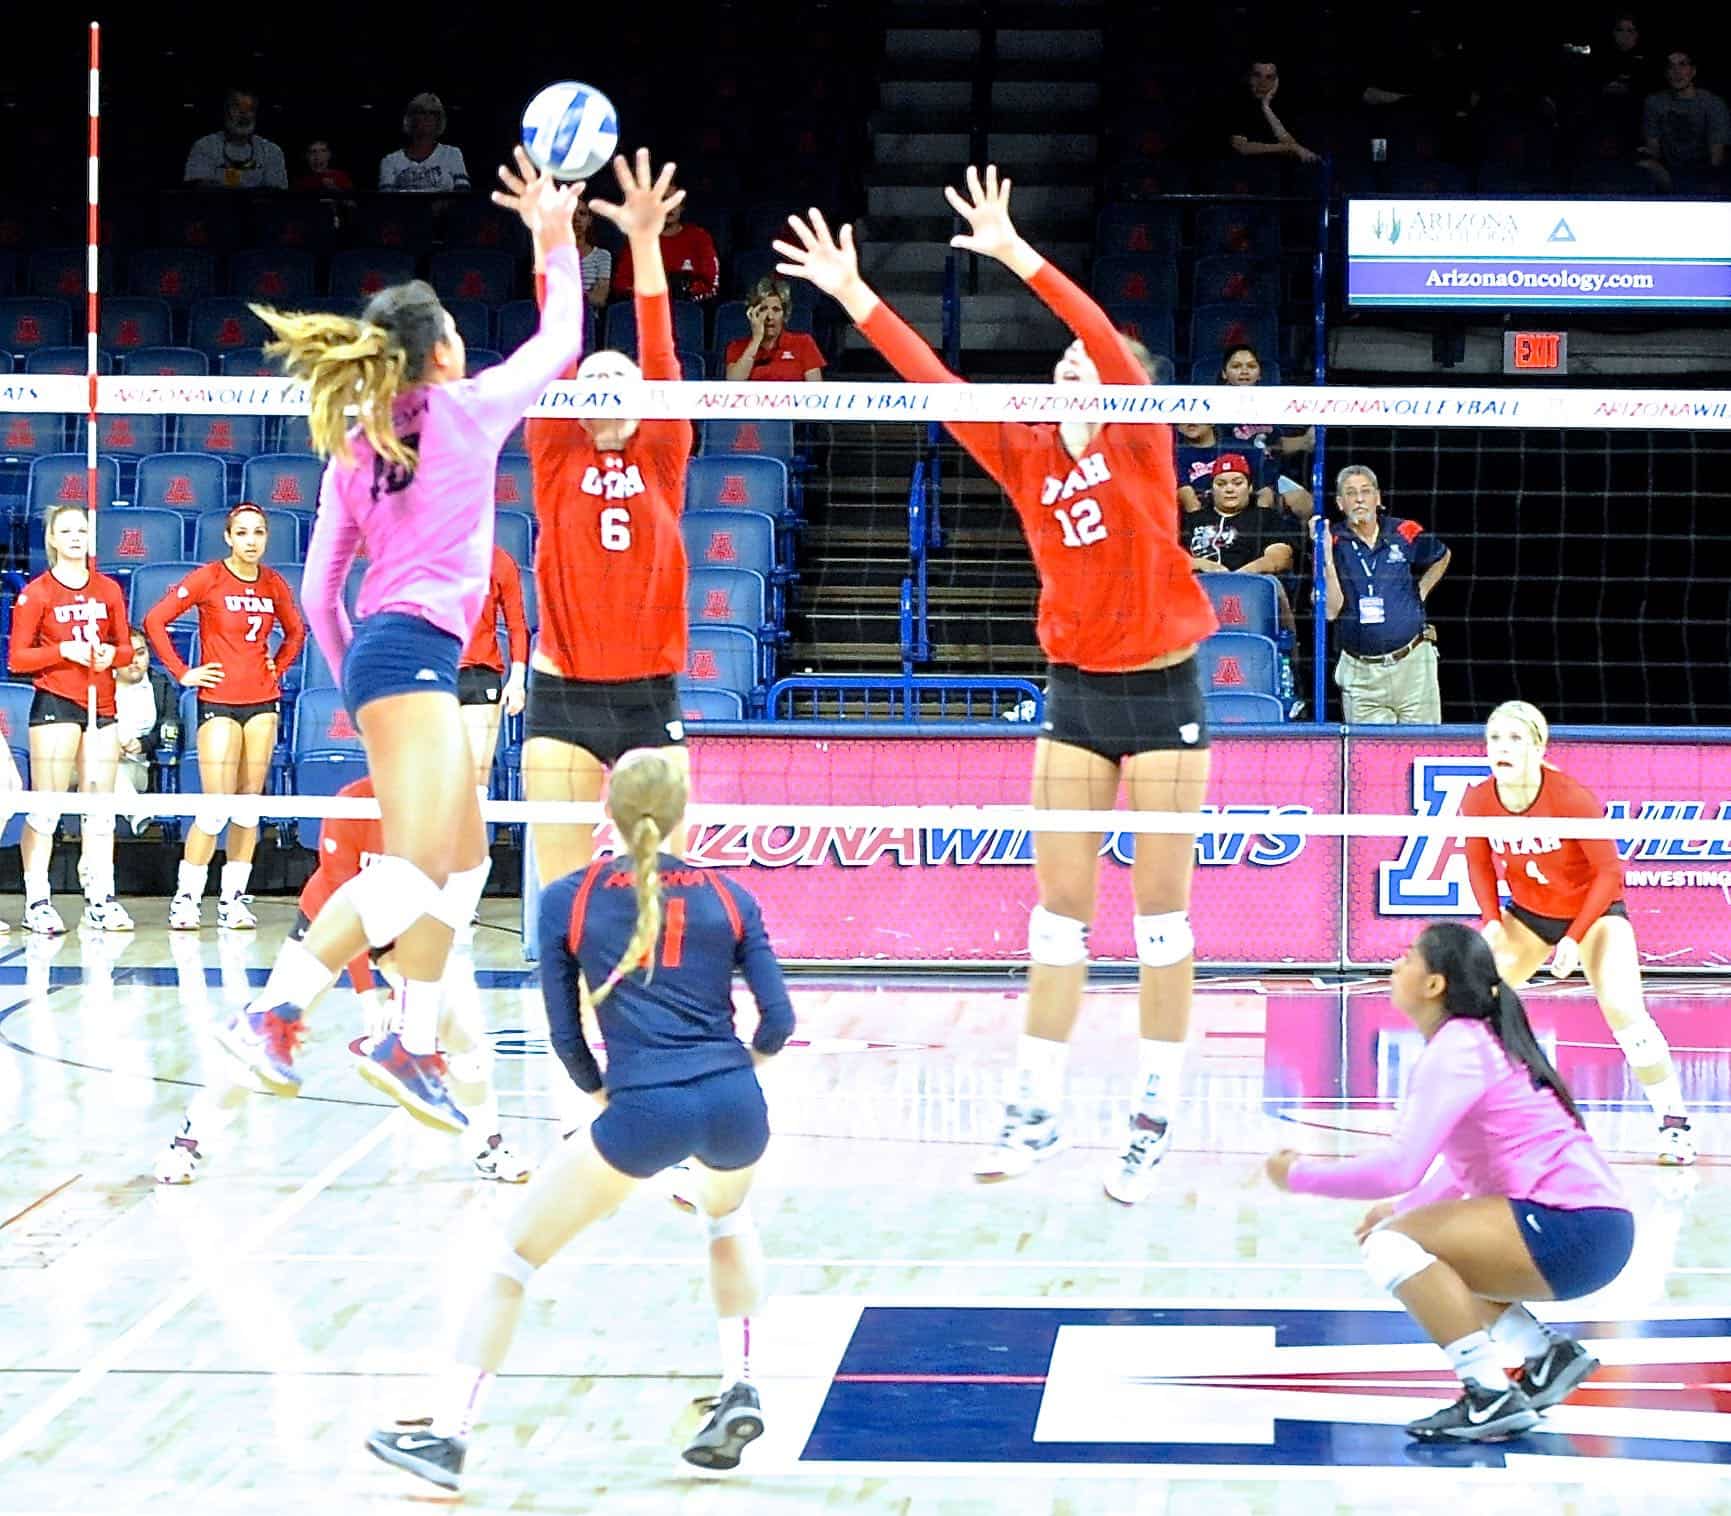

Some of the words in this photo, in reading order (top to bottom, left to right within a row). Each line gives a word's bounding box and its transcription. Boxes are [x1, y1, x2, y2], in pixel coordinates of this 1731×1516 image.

[1425, 269, 1655, 291] ArizonaOncology.com
[1514, 333, 1560, 368] EXIT
[600, 507, 632, 551] 6
[1053, 498, 1109, 547] 12
[224, 595, 275, 613] UTAH
[245, 615, 263, 642] 7
